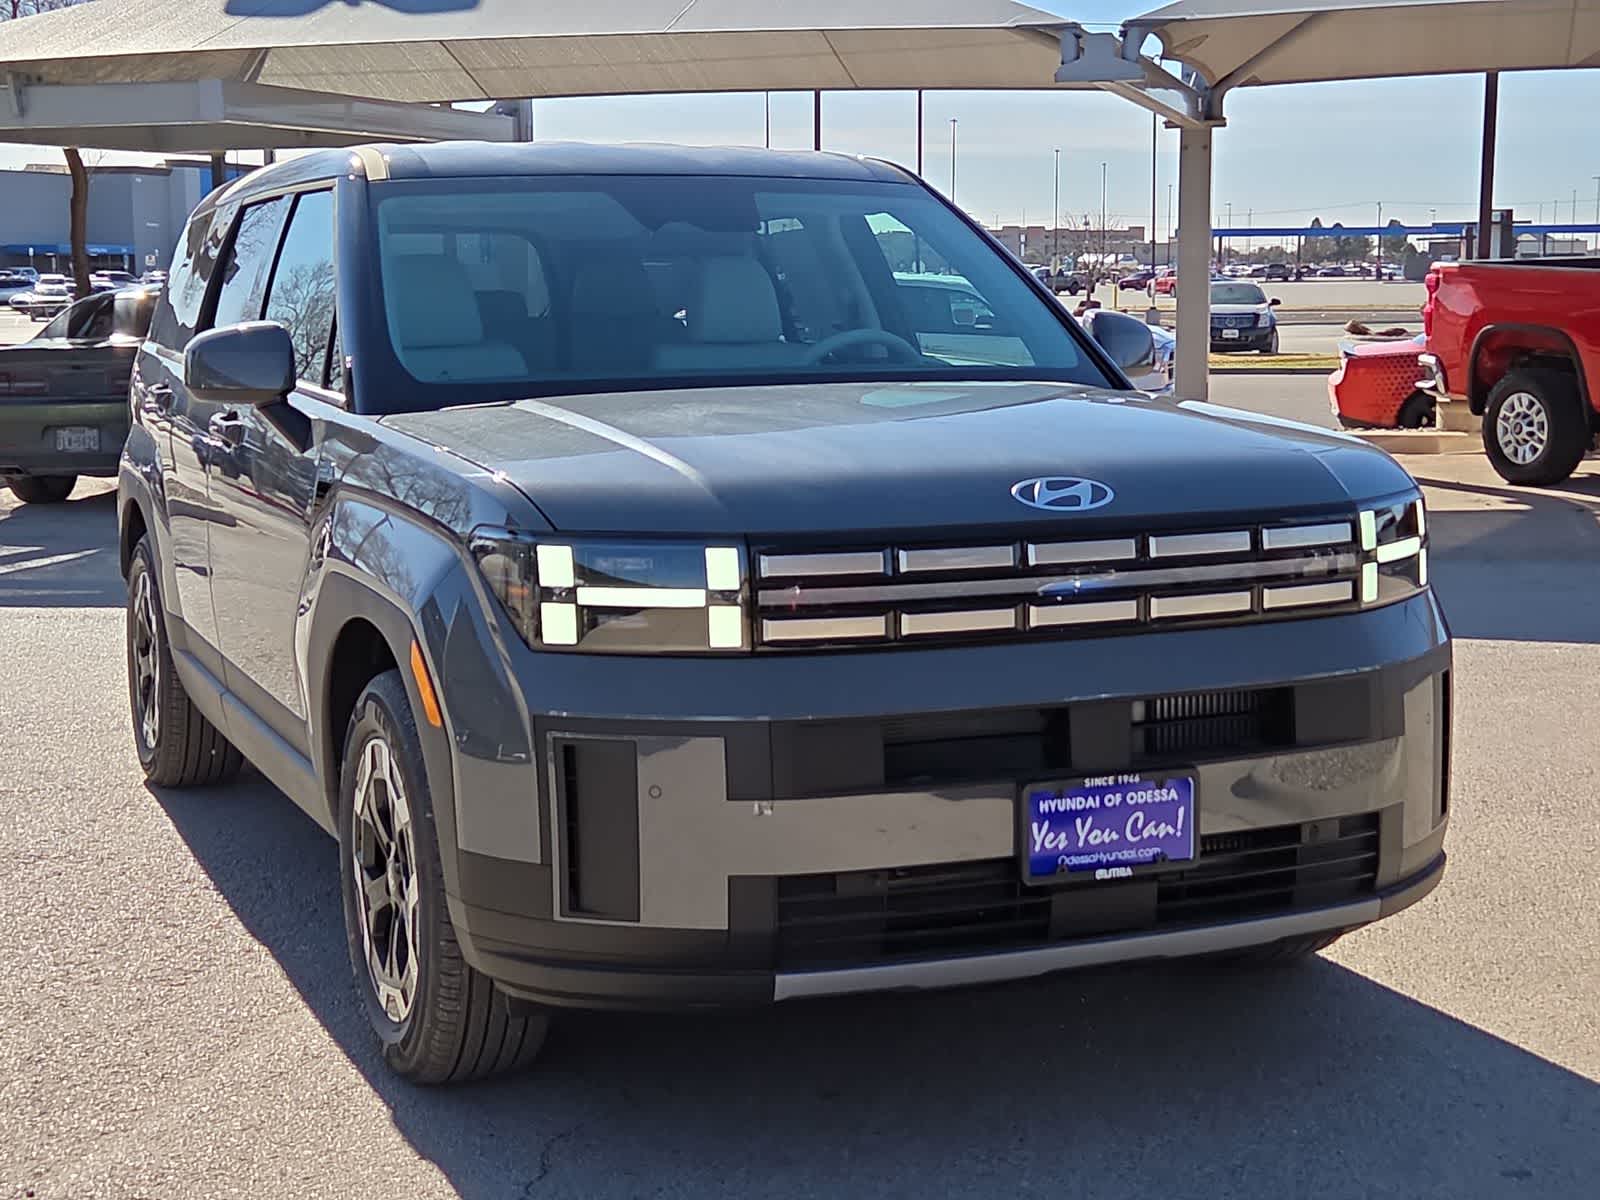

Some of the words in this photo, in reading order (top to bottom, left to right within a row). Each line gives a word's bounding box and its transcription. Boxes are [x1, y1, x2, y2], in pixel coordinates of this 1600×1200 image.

[1084, 777, 1114, 788] SINCE
[1039, 796, 1100, 813] HYUNDAI
[1104, 793, 1122, 807] OF
[1126, 788, 1178, 804] ODESSA
[1031, 820, 1068, 852] Yes
[1075, 816, 1119, 848] You
[1125, 806, 1184, 842] Can!
